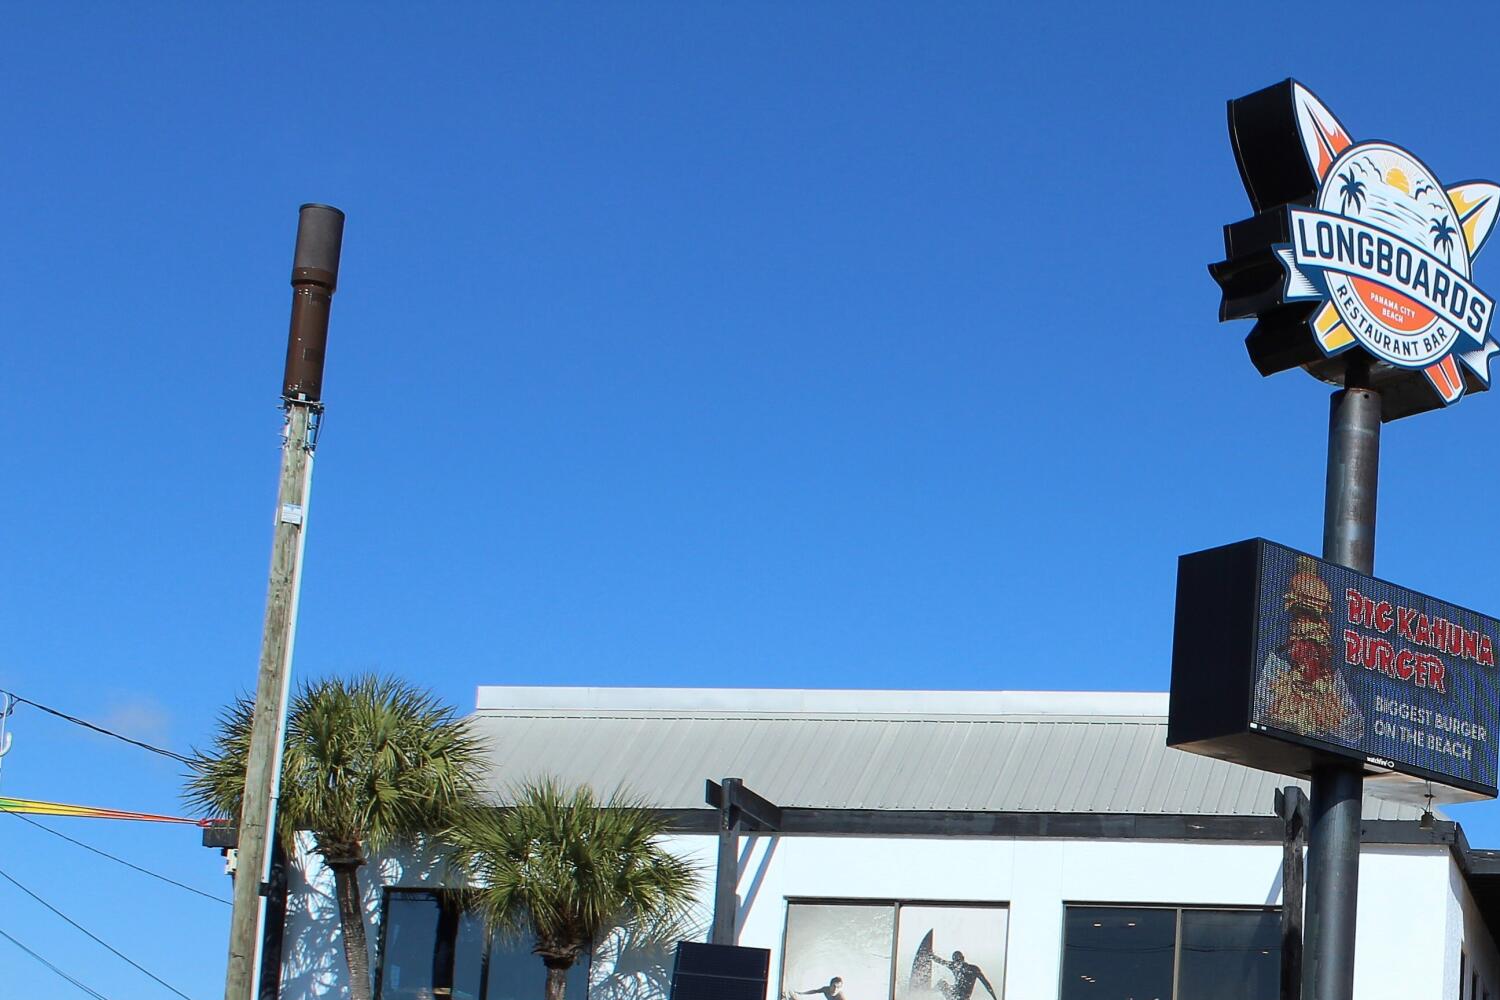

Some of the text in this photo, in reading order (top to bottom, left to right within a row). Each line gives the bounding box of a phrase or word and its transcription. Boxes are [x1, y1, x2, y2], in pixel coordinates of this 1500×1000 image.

[1298, 217, 1487, 334] LONGBOARDS
[1336, 284, 1449, 357] RESTAURANT BAR
[1370, 291, 1416, 319] PANAMA CITY
[1382, 307, 1404, 324] BEACH
[1346, 587, 1495, 667] BIG KAHUNA
[1344, 629, 1447, 694] BURGER
[1374, 720, 1425, 747] ON THE
[1376, 695, 1487, 742] BIGGEST BURGER
[1427, 735, 1472, 761] BEACH
